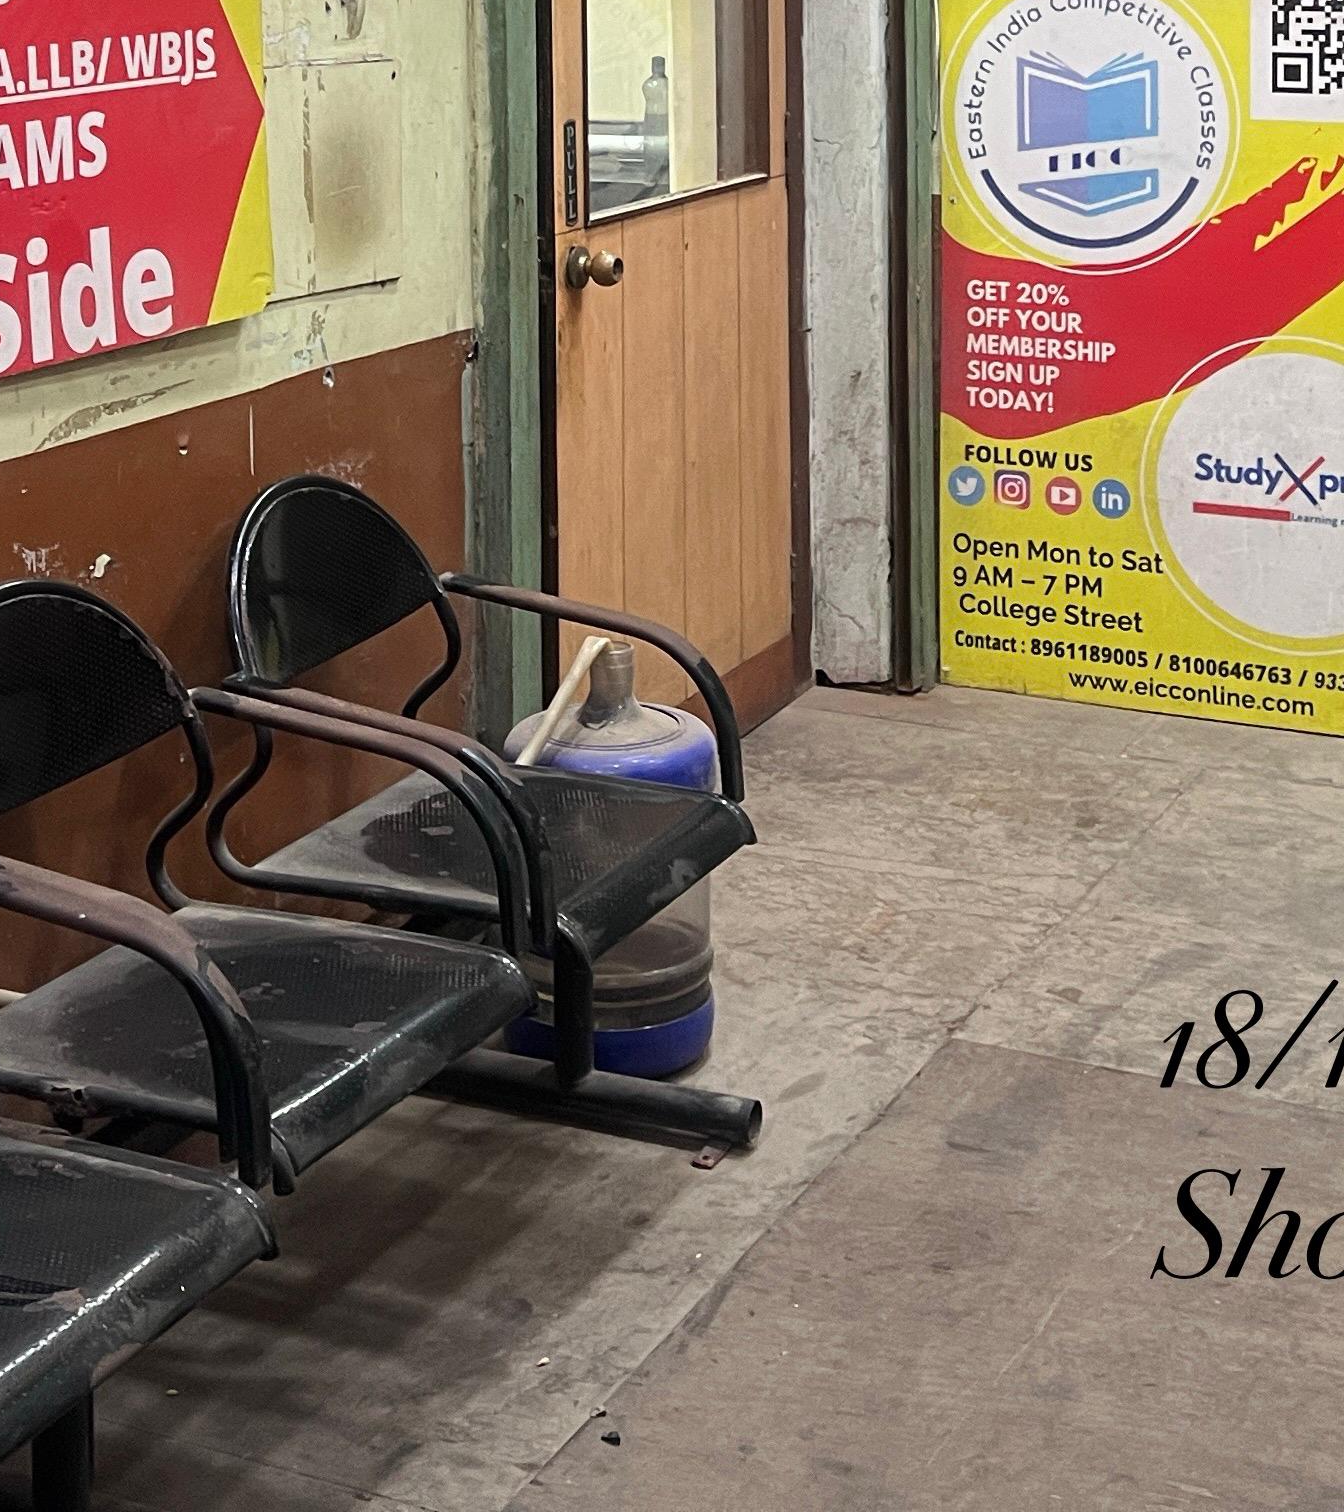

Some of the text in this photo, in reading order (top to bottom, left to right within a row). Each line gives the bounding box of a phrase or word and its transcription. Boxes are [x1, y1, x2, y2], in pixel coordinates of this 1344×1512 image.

[122, 26, 216, 87] WBJS
[964, 58, 995, 160] Eastern
[987, 6, 1042, 53] India
[1190, 66, 1216, 169] Classes
[566, 126, 576, 219] PULL
[967, 280, 1069, 306] GET 20%
[967, 307, 1082, 334] OFF YOUR
[966, 333, 1116, 363] MEMBERSHIP
[967, 362, 1059, 386] SIGN UP
[966, 388, 1055, 413] TODAY!
[965, 444, 1093, 472] FOLLOW US
[1291, 513, 1337, 527] Learning
[953, 534, 1163, 574] Open Mon to Sat
[953, 567, 1102, 597] 9 AM 7 PM
[959, 593, 1143, 632] College Street
[955, 630, 1018, 653] Contact
[1030, 638, 1148, 668] 8961189005
[1169, 653, 1291, 686] 8100646763
[1069, 672, 1314, 717] www.eicconline.com
